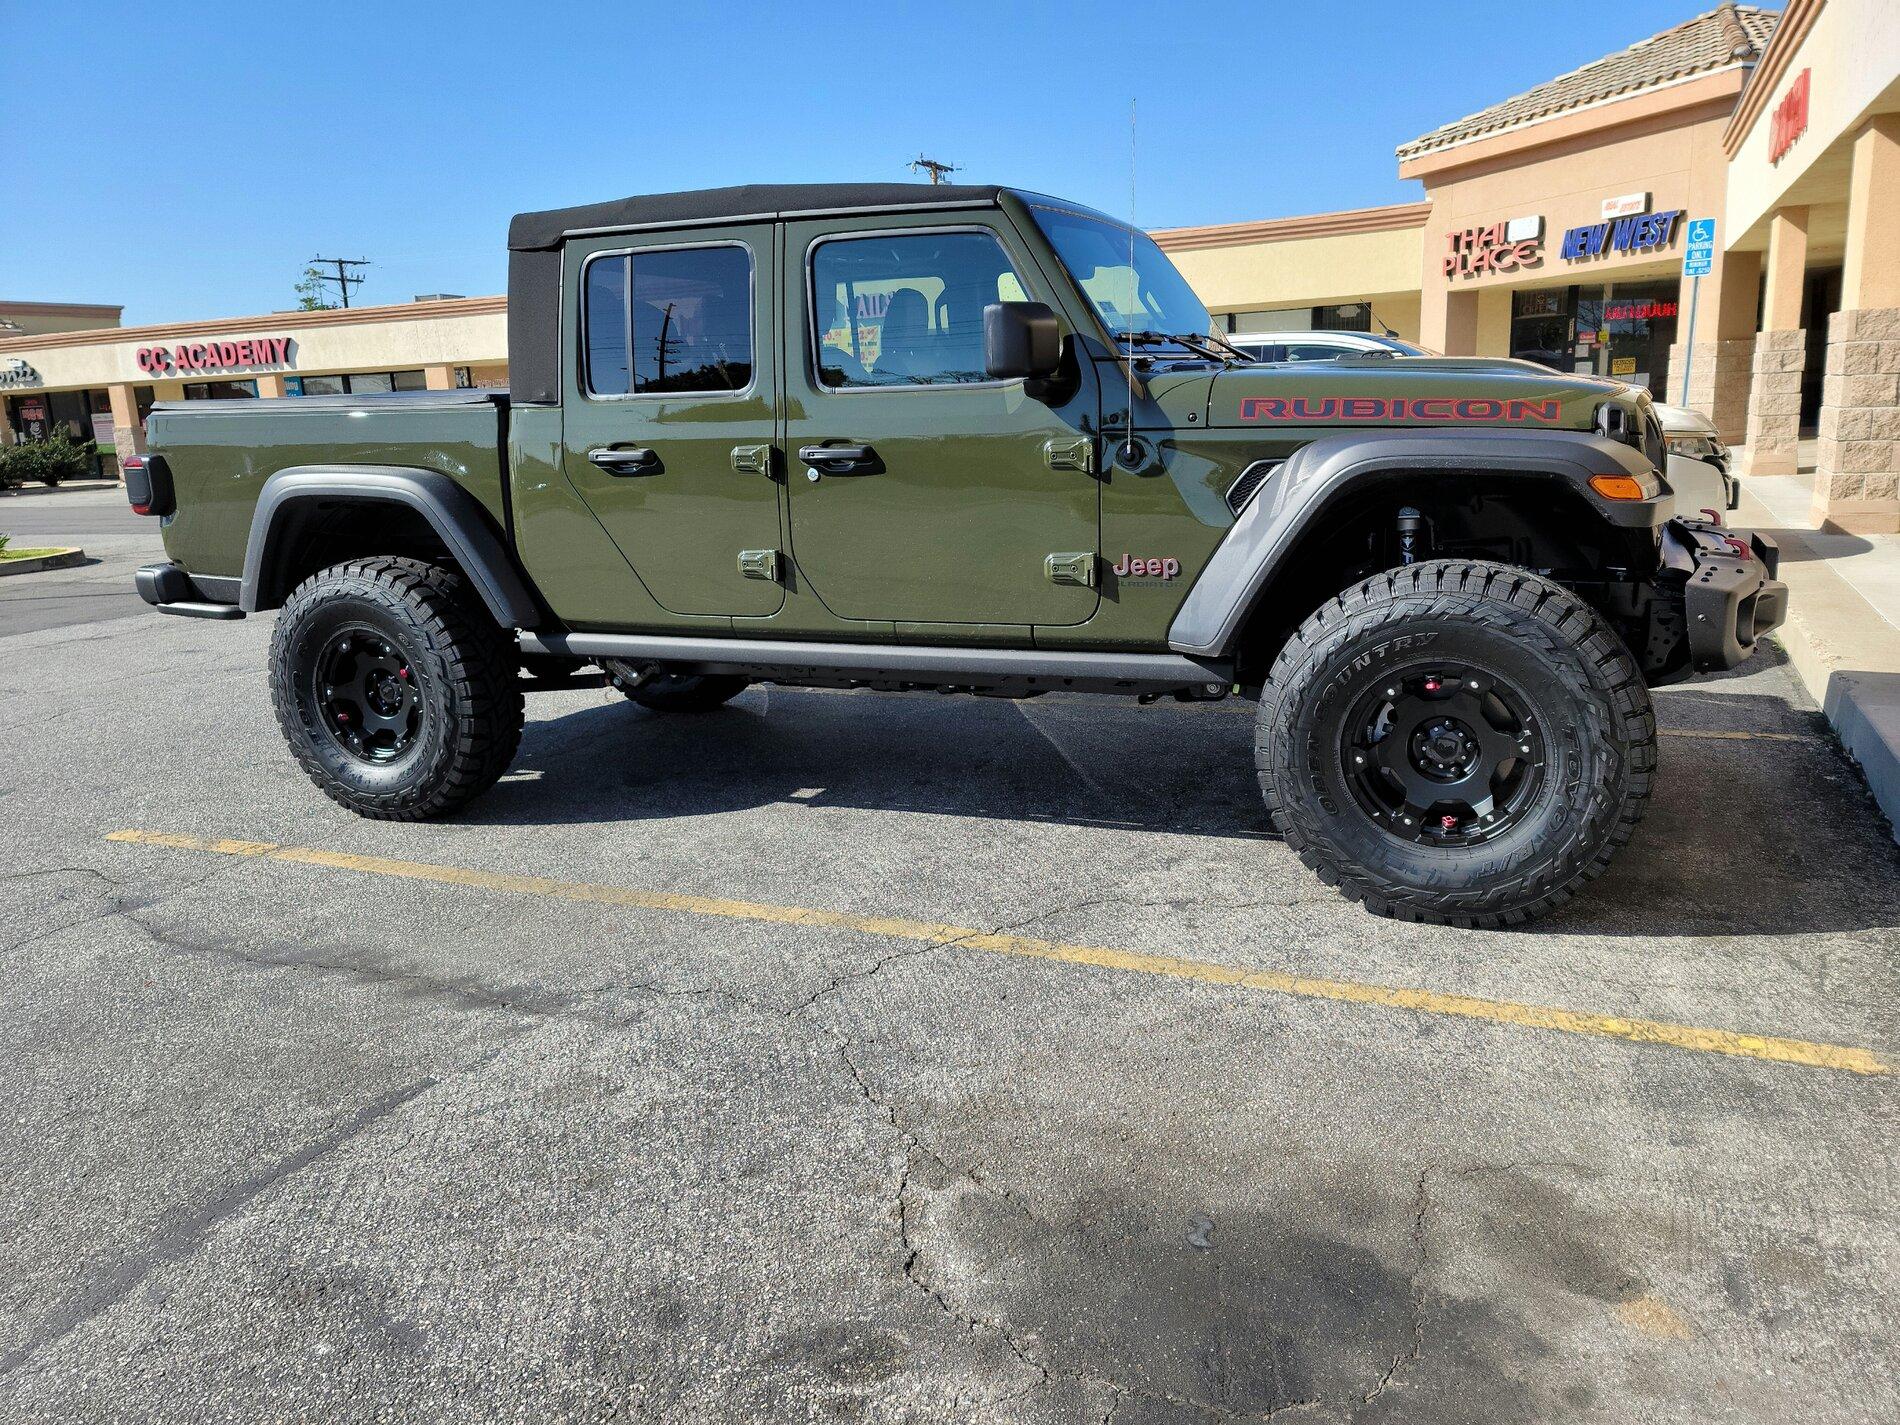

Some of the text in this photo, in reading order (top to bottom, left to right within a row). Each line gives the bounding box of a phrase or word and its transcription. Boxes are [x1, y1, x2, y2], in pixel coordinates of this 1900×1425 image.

[1445, 221, 1506, 252] THAI
[1560, 210, 1681, 259] NEW WEST
[1688, 241, 1713, 250] PARKING
[1442, 240, 1540, 277] PLACE
[1691, 250, 1706, 259] ONLY
[136, 337, 289, 372] CC ACADEMY
[1241, 398, 1561, 421] RUBICON
[1113, 553, 1179, 580] Jeep
[1314, 632, 1440, 721] COUNTRY
